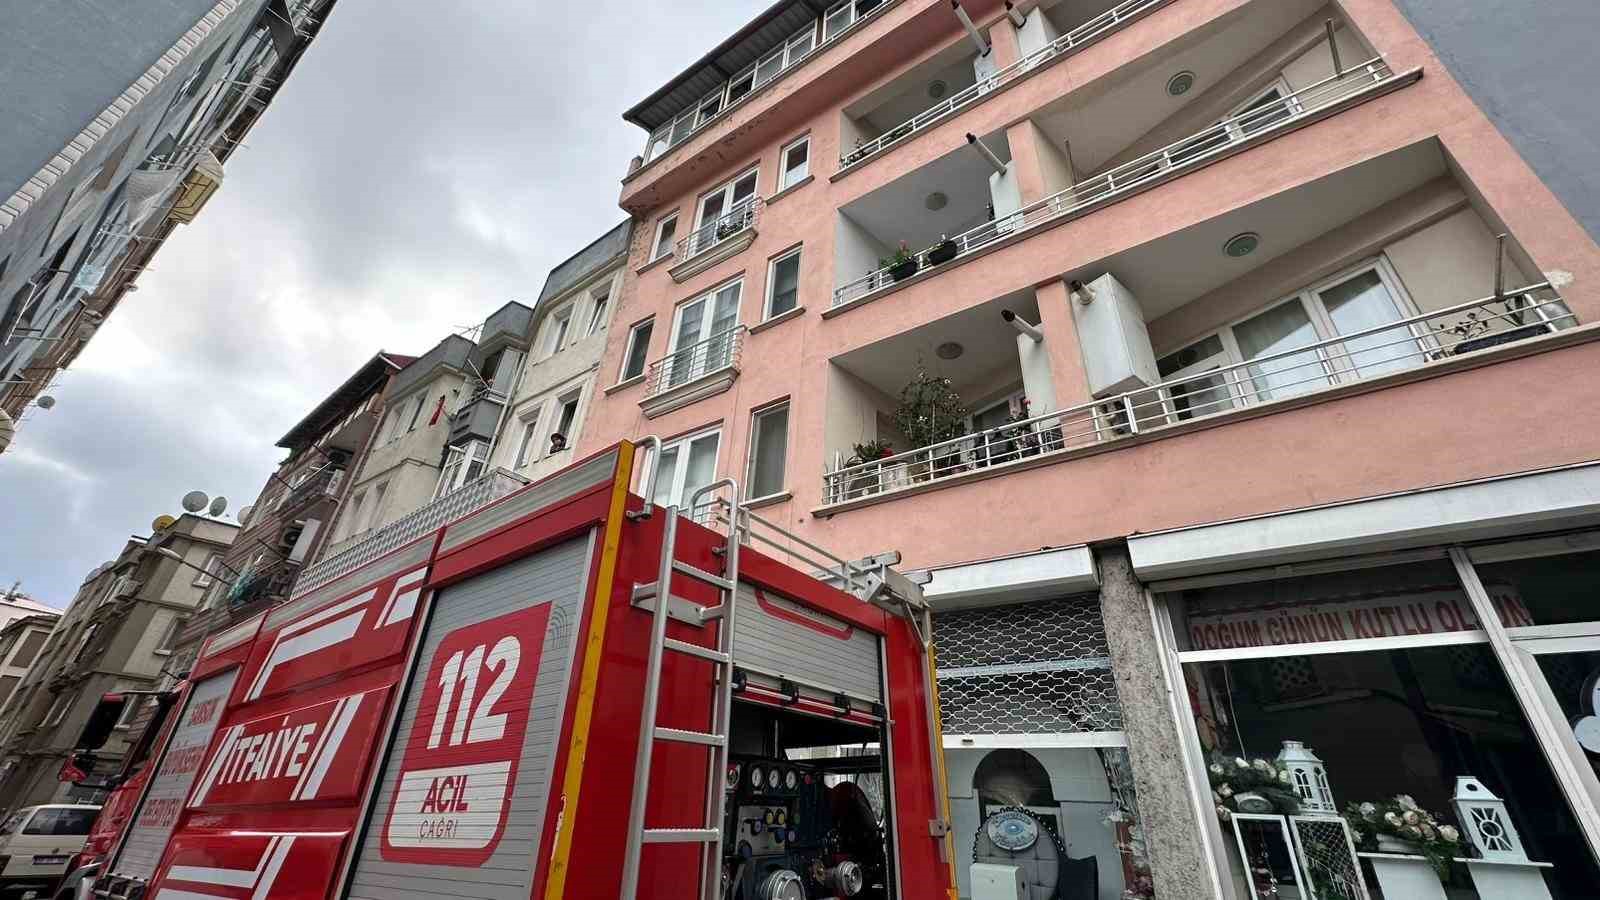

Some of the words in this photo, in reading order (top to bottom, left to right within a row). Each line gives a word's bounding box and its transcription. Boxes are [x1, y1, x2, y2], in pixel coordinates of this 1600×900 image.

[1348, 602, 1432, 639] KUTLU
[426, 635, 521, 750] 112
[218, 714, 317, 785] İTFAİYE
